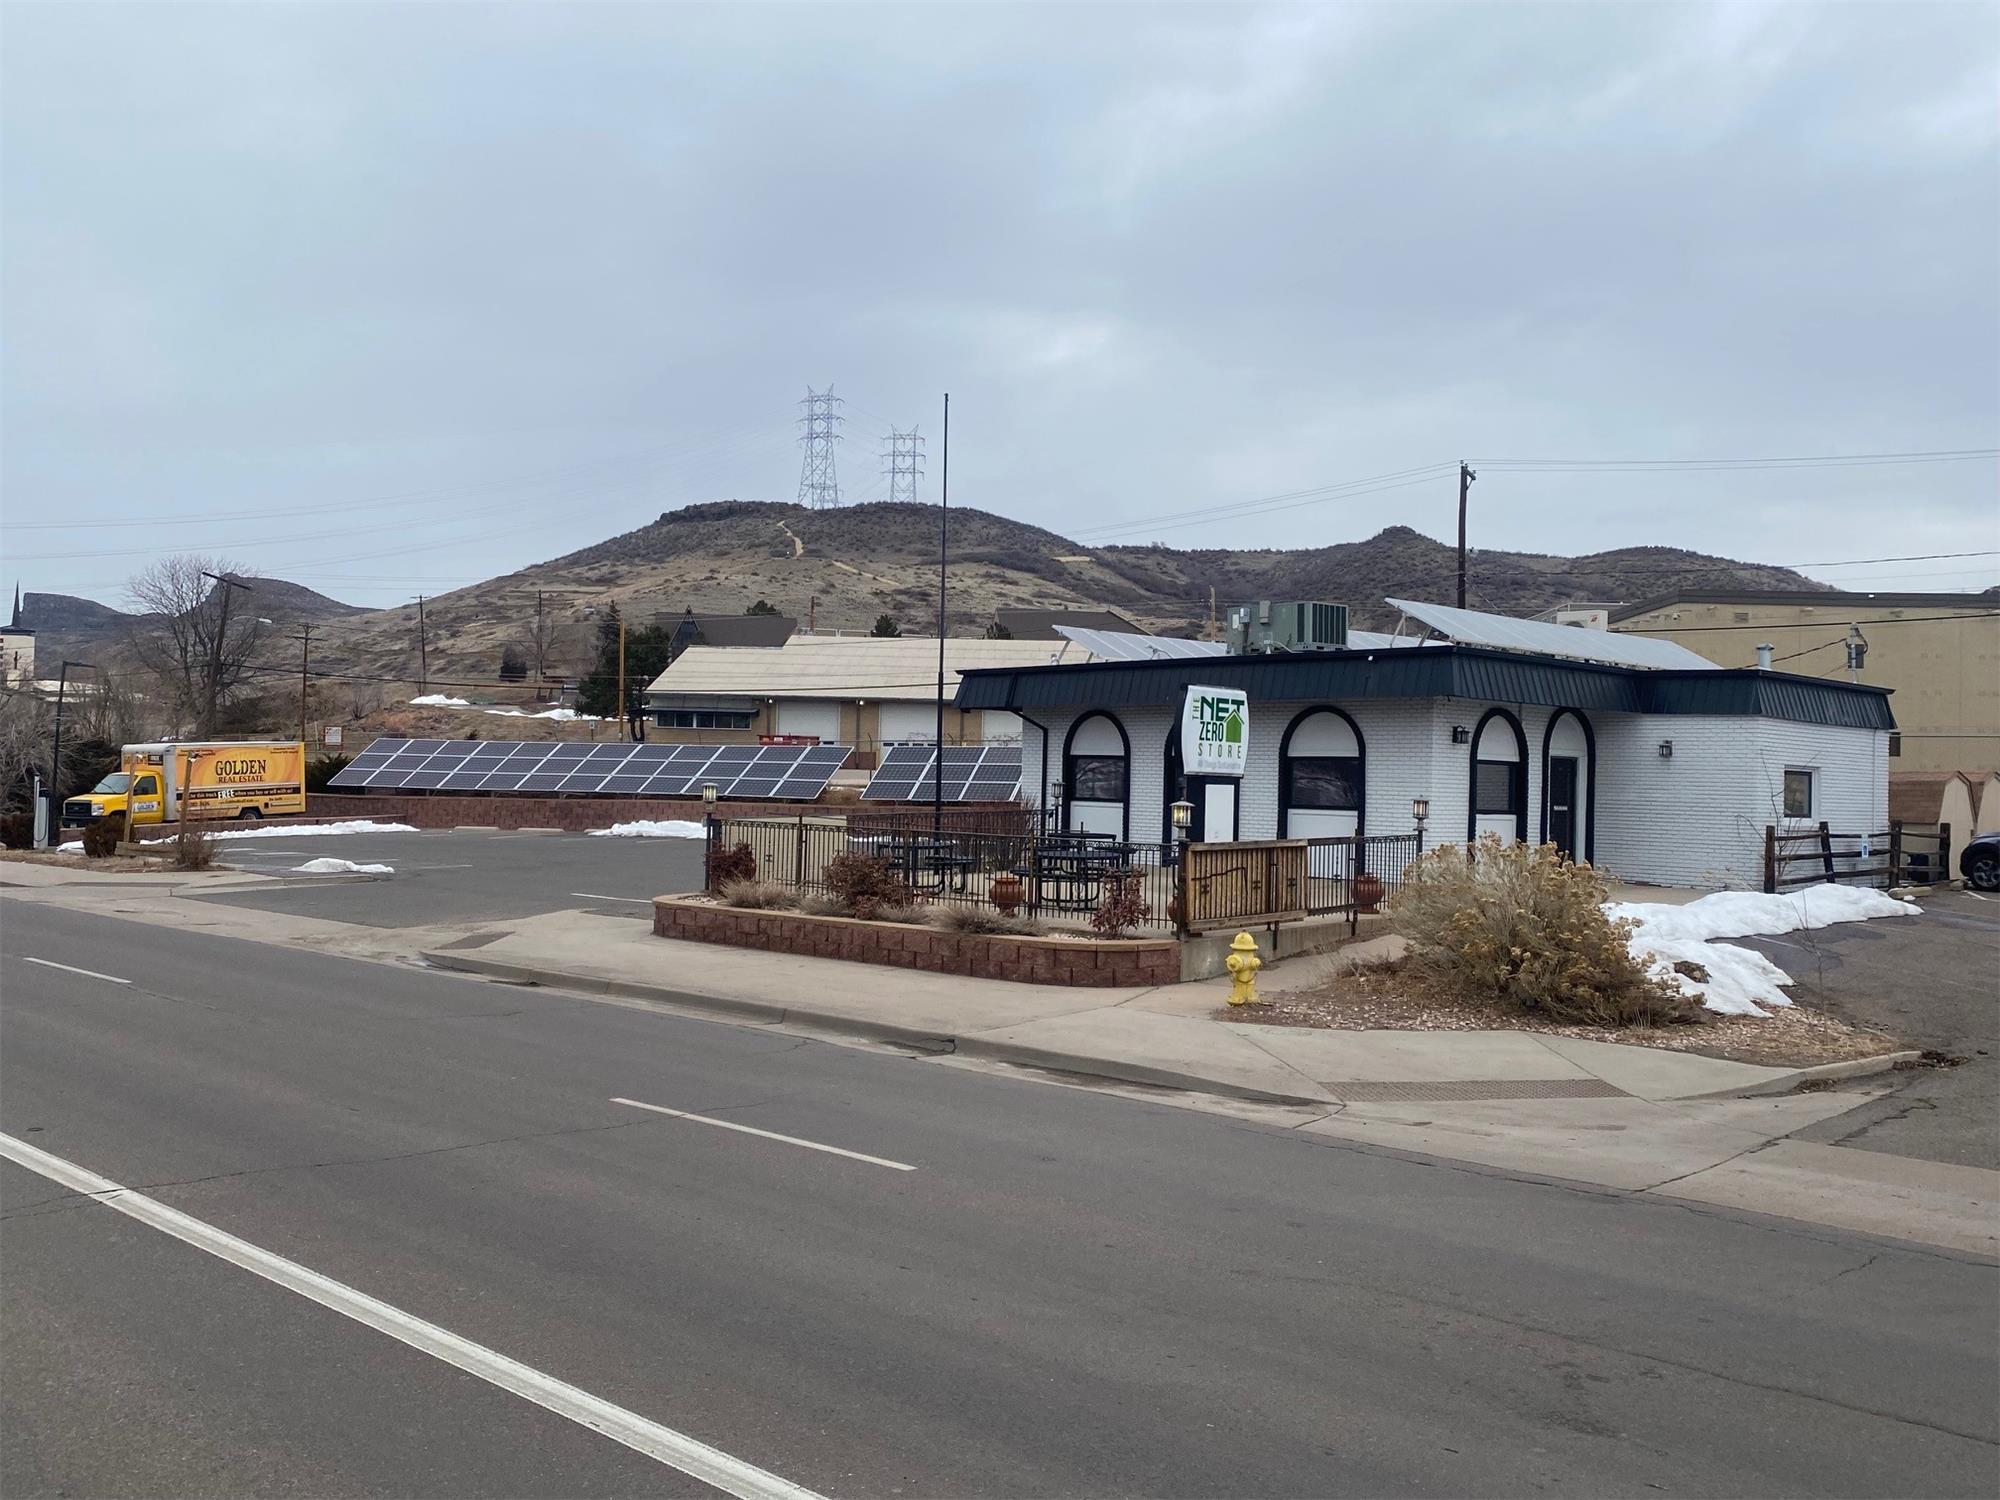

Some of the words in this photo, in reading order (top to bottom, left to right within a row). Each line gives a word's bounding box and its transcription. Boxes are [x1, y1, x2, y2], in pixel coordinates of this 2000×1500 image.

[1192, 697, 1200, 720] THE
[1200, 696, 1245, 721] NET
[1199, 721, 1224, 741] ZERO
[1198, 743, 1241, 759] STORE
[215, 759, 267, 776] GOLDEN
[239, 775, 264, 783] ESTATE
[217, 789, 235, 799] FREE
